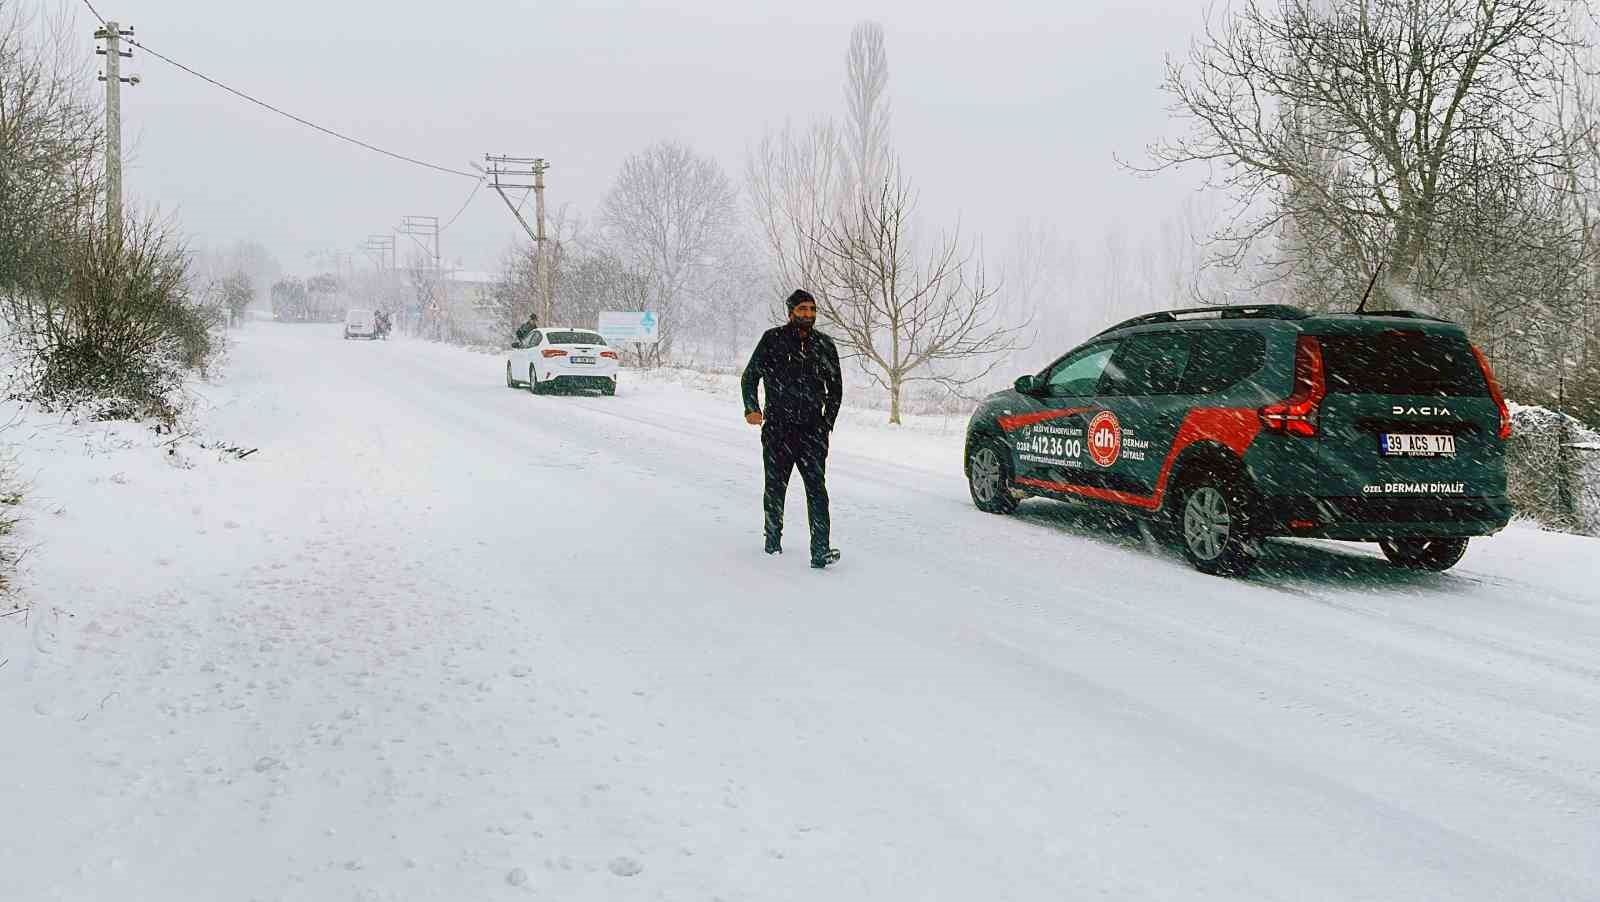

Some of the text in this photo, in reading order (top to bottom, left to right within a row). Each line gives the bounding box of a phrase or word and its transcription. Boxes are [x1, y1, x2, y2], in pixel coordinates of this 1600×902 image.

[1392, 406, 1451, 416] DACIA
[1095, 428, 1114, 449] dh
[1122, 438, 1149, 449] DERMAN
[1388, 436, 1454, 451] 39 ACS 171
[1032, 436, 1049, 454] 412
[1050, 437, 1063, 456] 36
[1065, 438, 1081, 458] 00
[1363, 481, 1464, 493] ÖZEL DERMAN DİYALİZ
